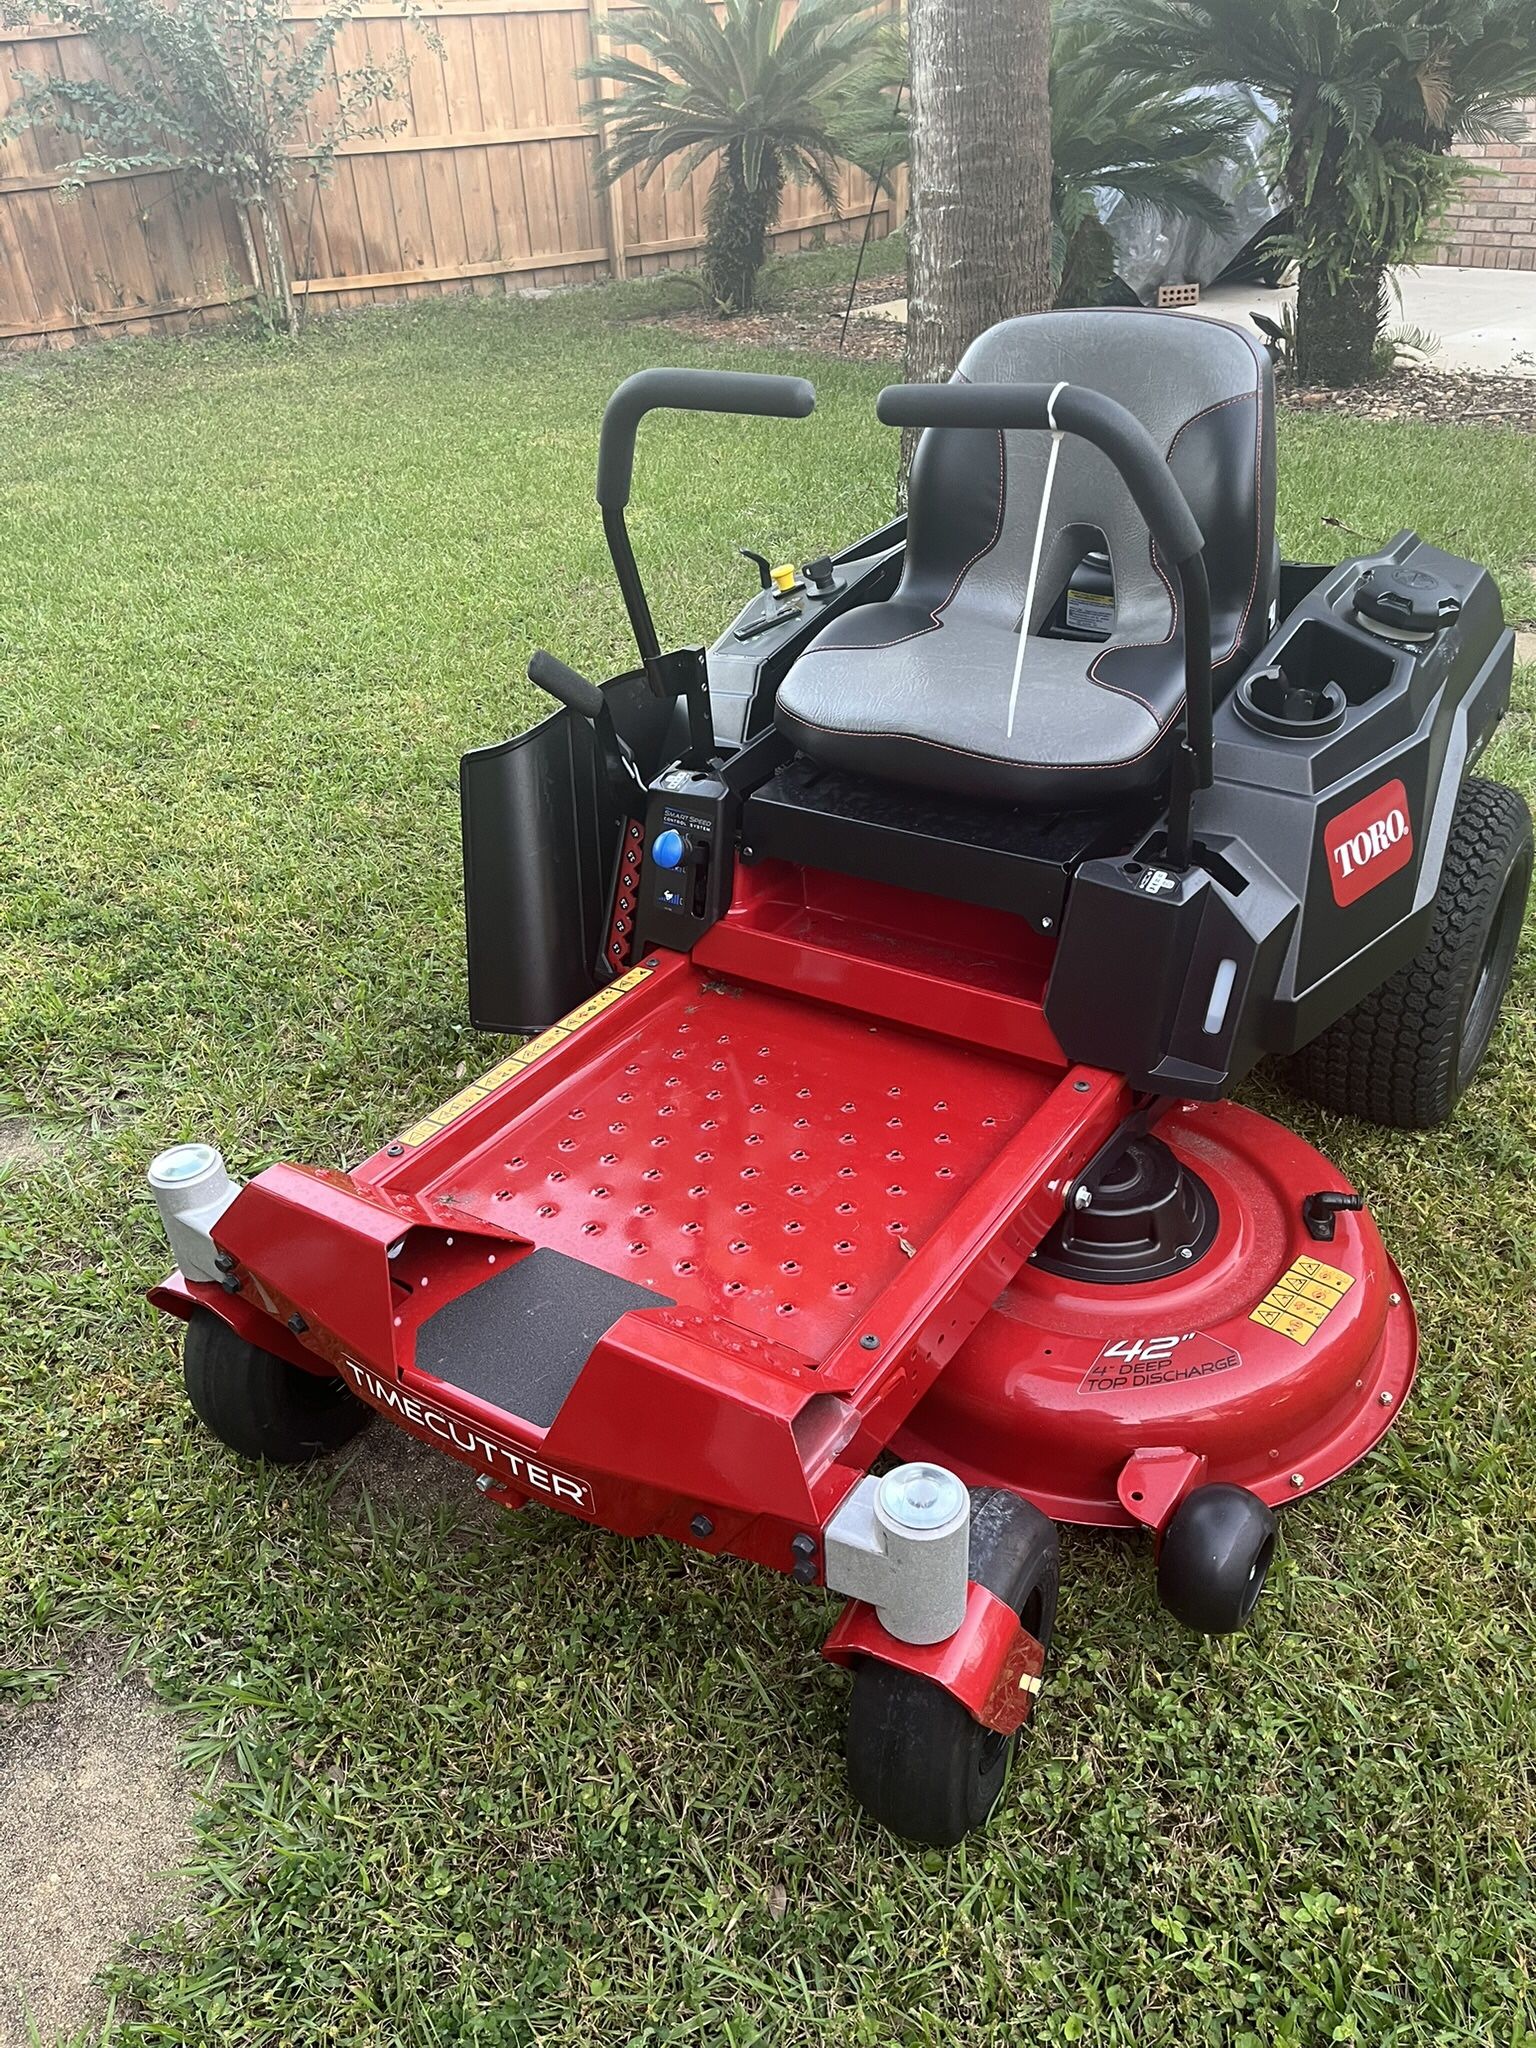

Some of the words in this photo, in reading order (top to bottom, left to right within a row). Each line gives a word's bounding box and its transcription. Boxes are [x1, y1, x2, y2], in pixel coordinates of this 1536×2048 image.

[663, 816, 687, 827] CONTROL
[690, 823, 711, 832] SYSTEM
[664, 810, 689, 820] SMART
[689, 816, 712, 827] SPEED
[1333, 809, 1406, 879] TORO
[1103, 1332, 1197, 1363] 42"
[1088, 1377, 1128, 1392] TOP
[1133, 1354, 1239, 1387] DISCHARGE
[1119, 1359, 1173, 1375] DEEP
[345, 1359, 585, 1507] TIMECUTTER
